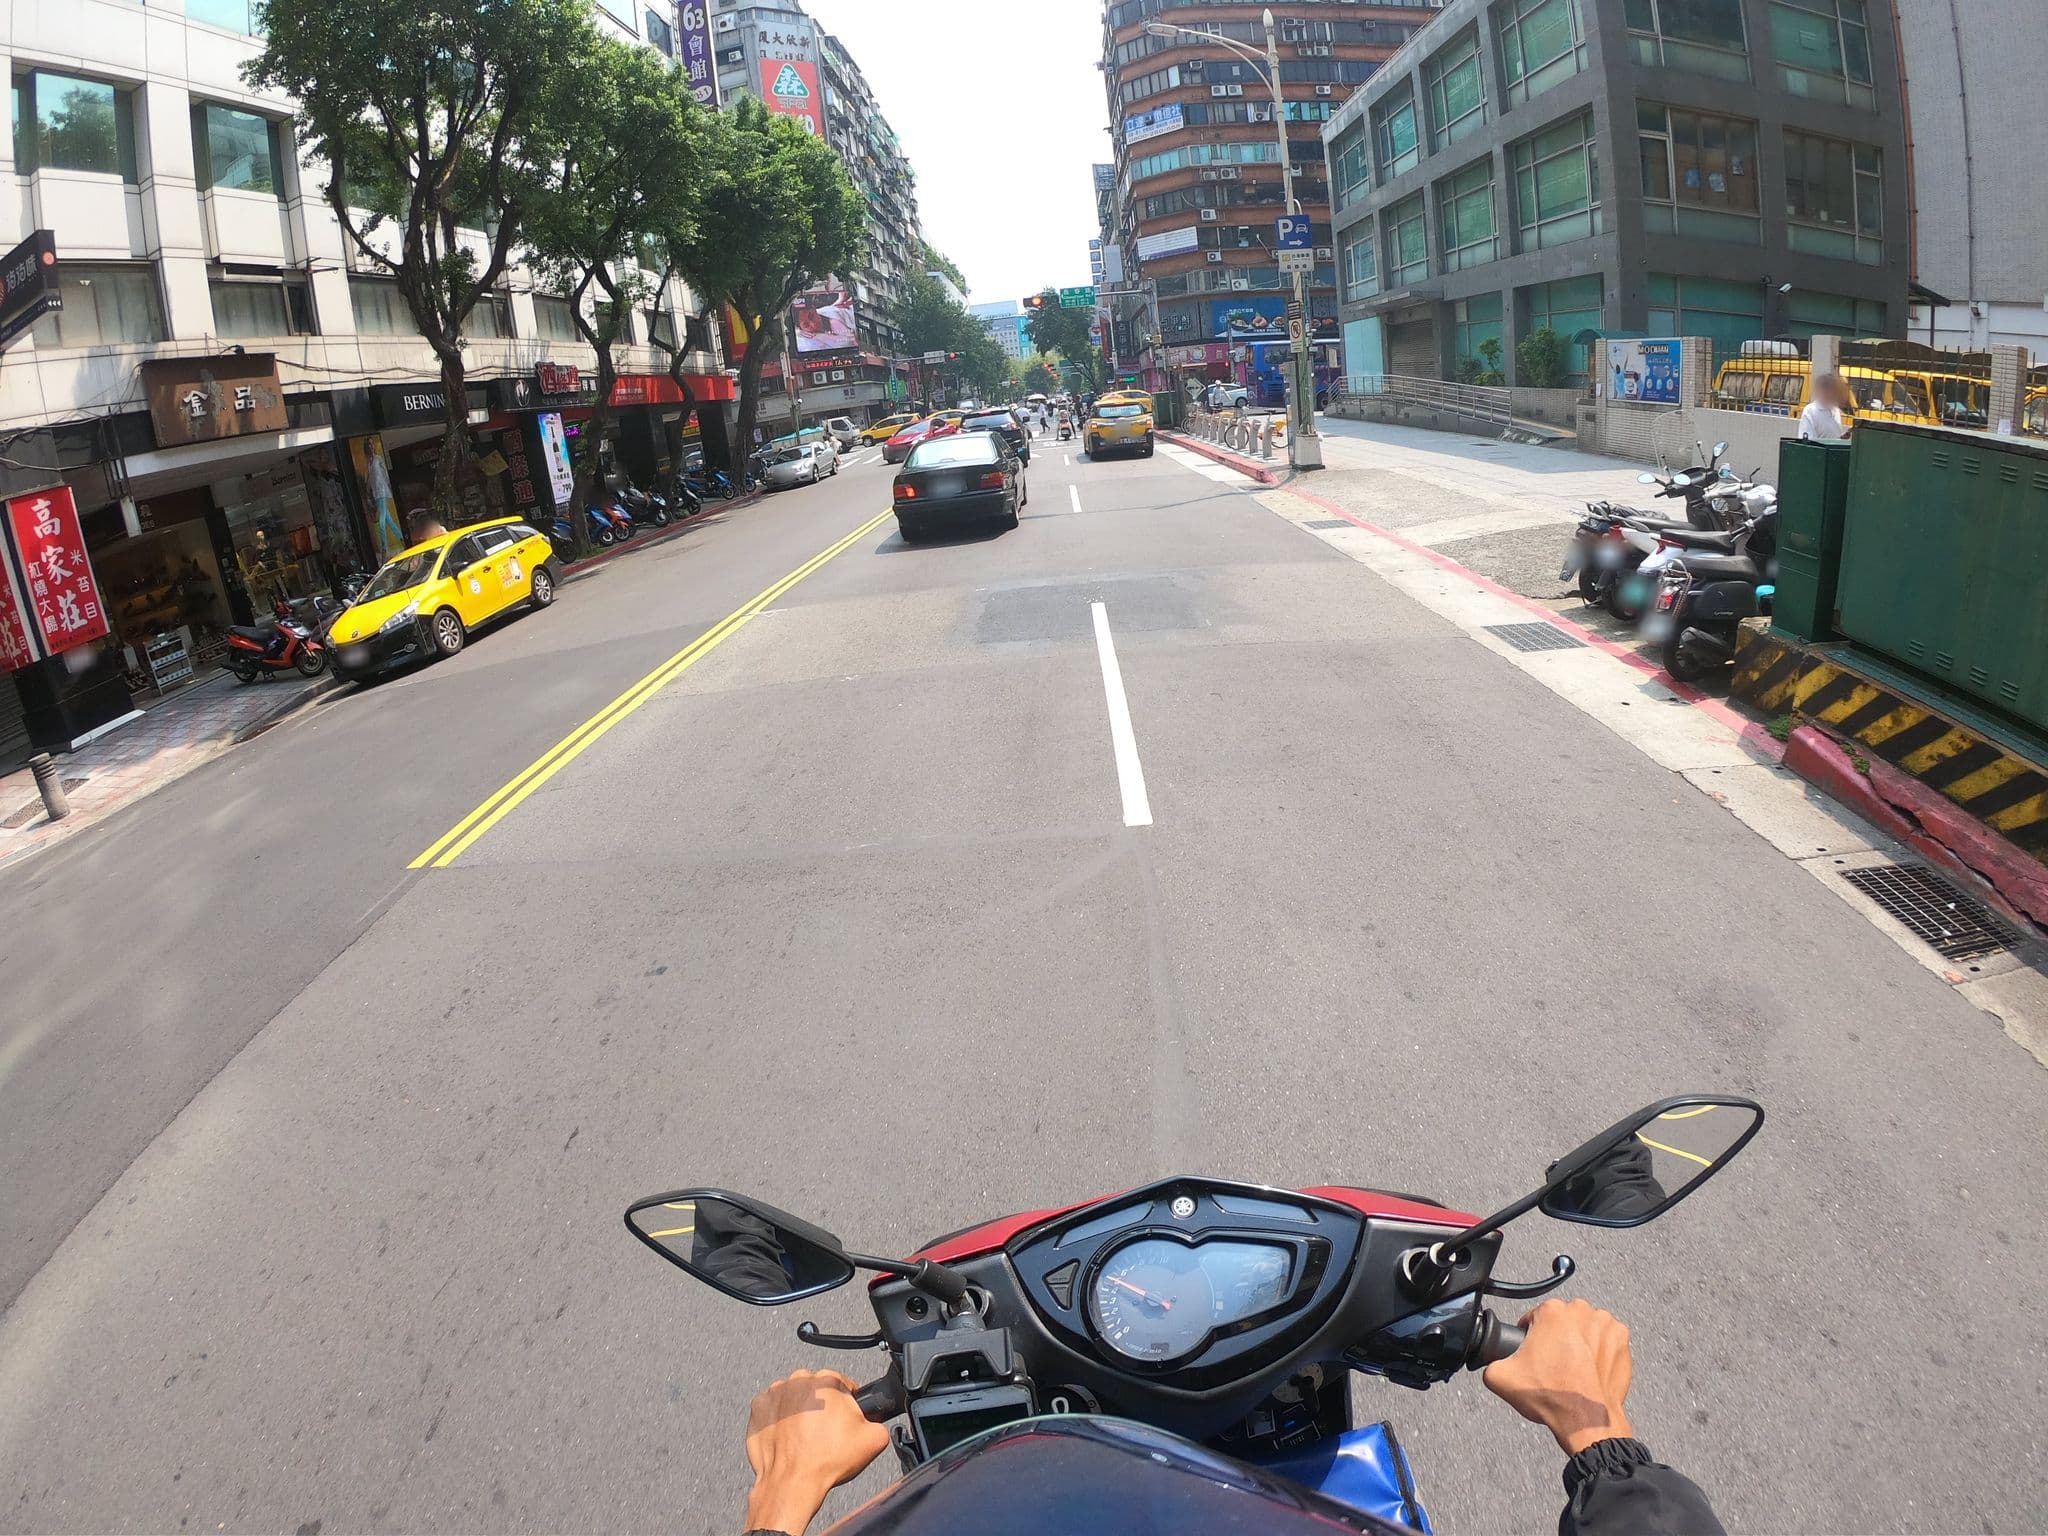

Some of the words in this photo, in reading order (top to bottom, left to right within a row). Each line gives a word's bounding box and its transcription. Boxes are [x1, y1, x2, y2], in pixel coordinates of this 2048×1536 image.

[776, 68, 804, 95] 森
[1278, 218, 1293, 241] P
[30, 498, 88, 633] 高家莊
[70, 549, 98, 619] 米苔目
